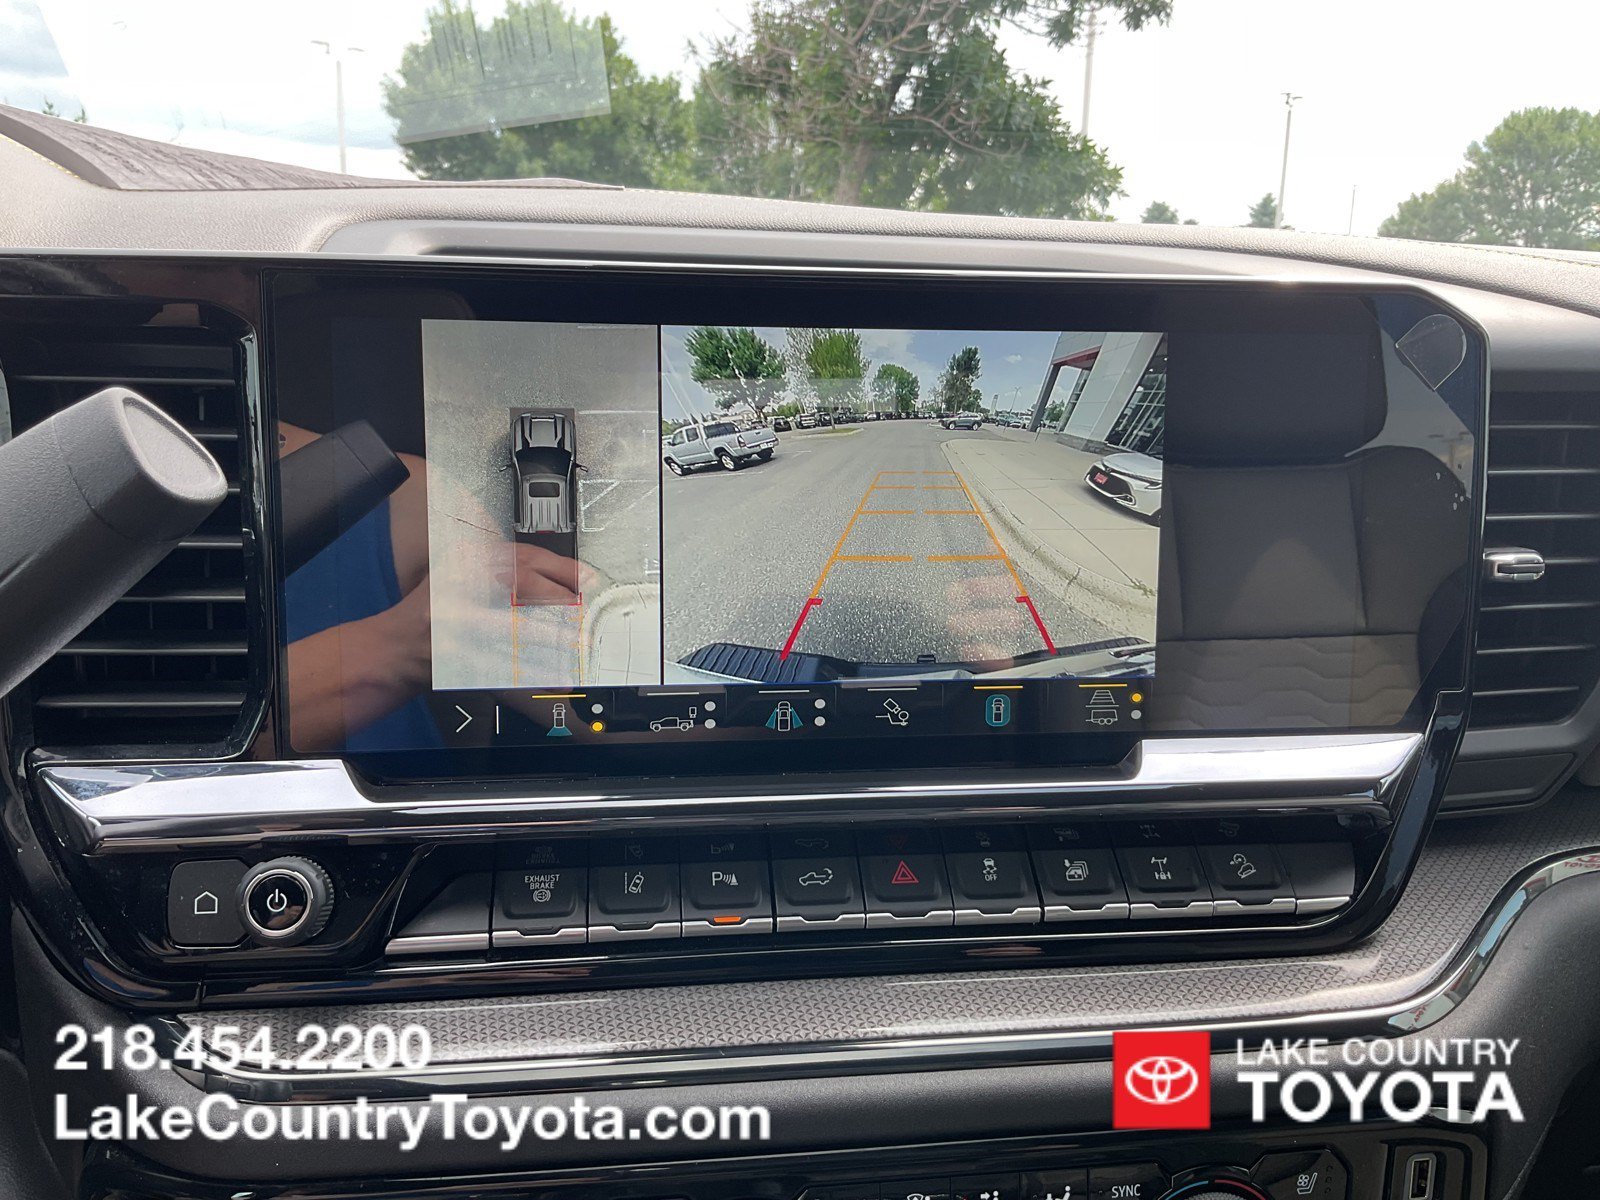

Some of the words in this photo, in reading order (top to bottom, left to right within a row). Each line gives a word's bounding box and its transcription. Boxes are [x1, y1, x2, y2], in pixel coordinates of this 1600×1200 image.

[524, 873, 560, 883] EXHAUST
[985, 873, 997, 881] OFF
[530, 881, 554, 889] BRAKE
[1112, 1184, 1140, 1198] SYNC
